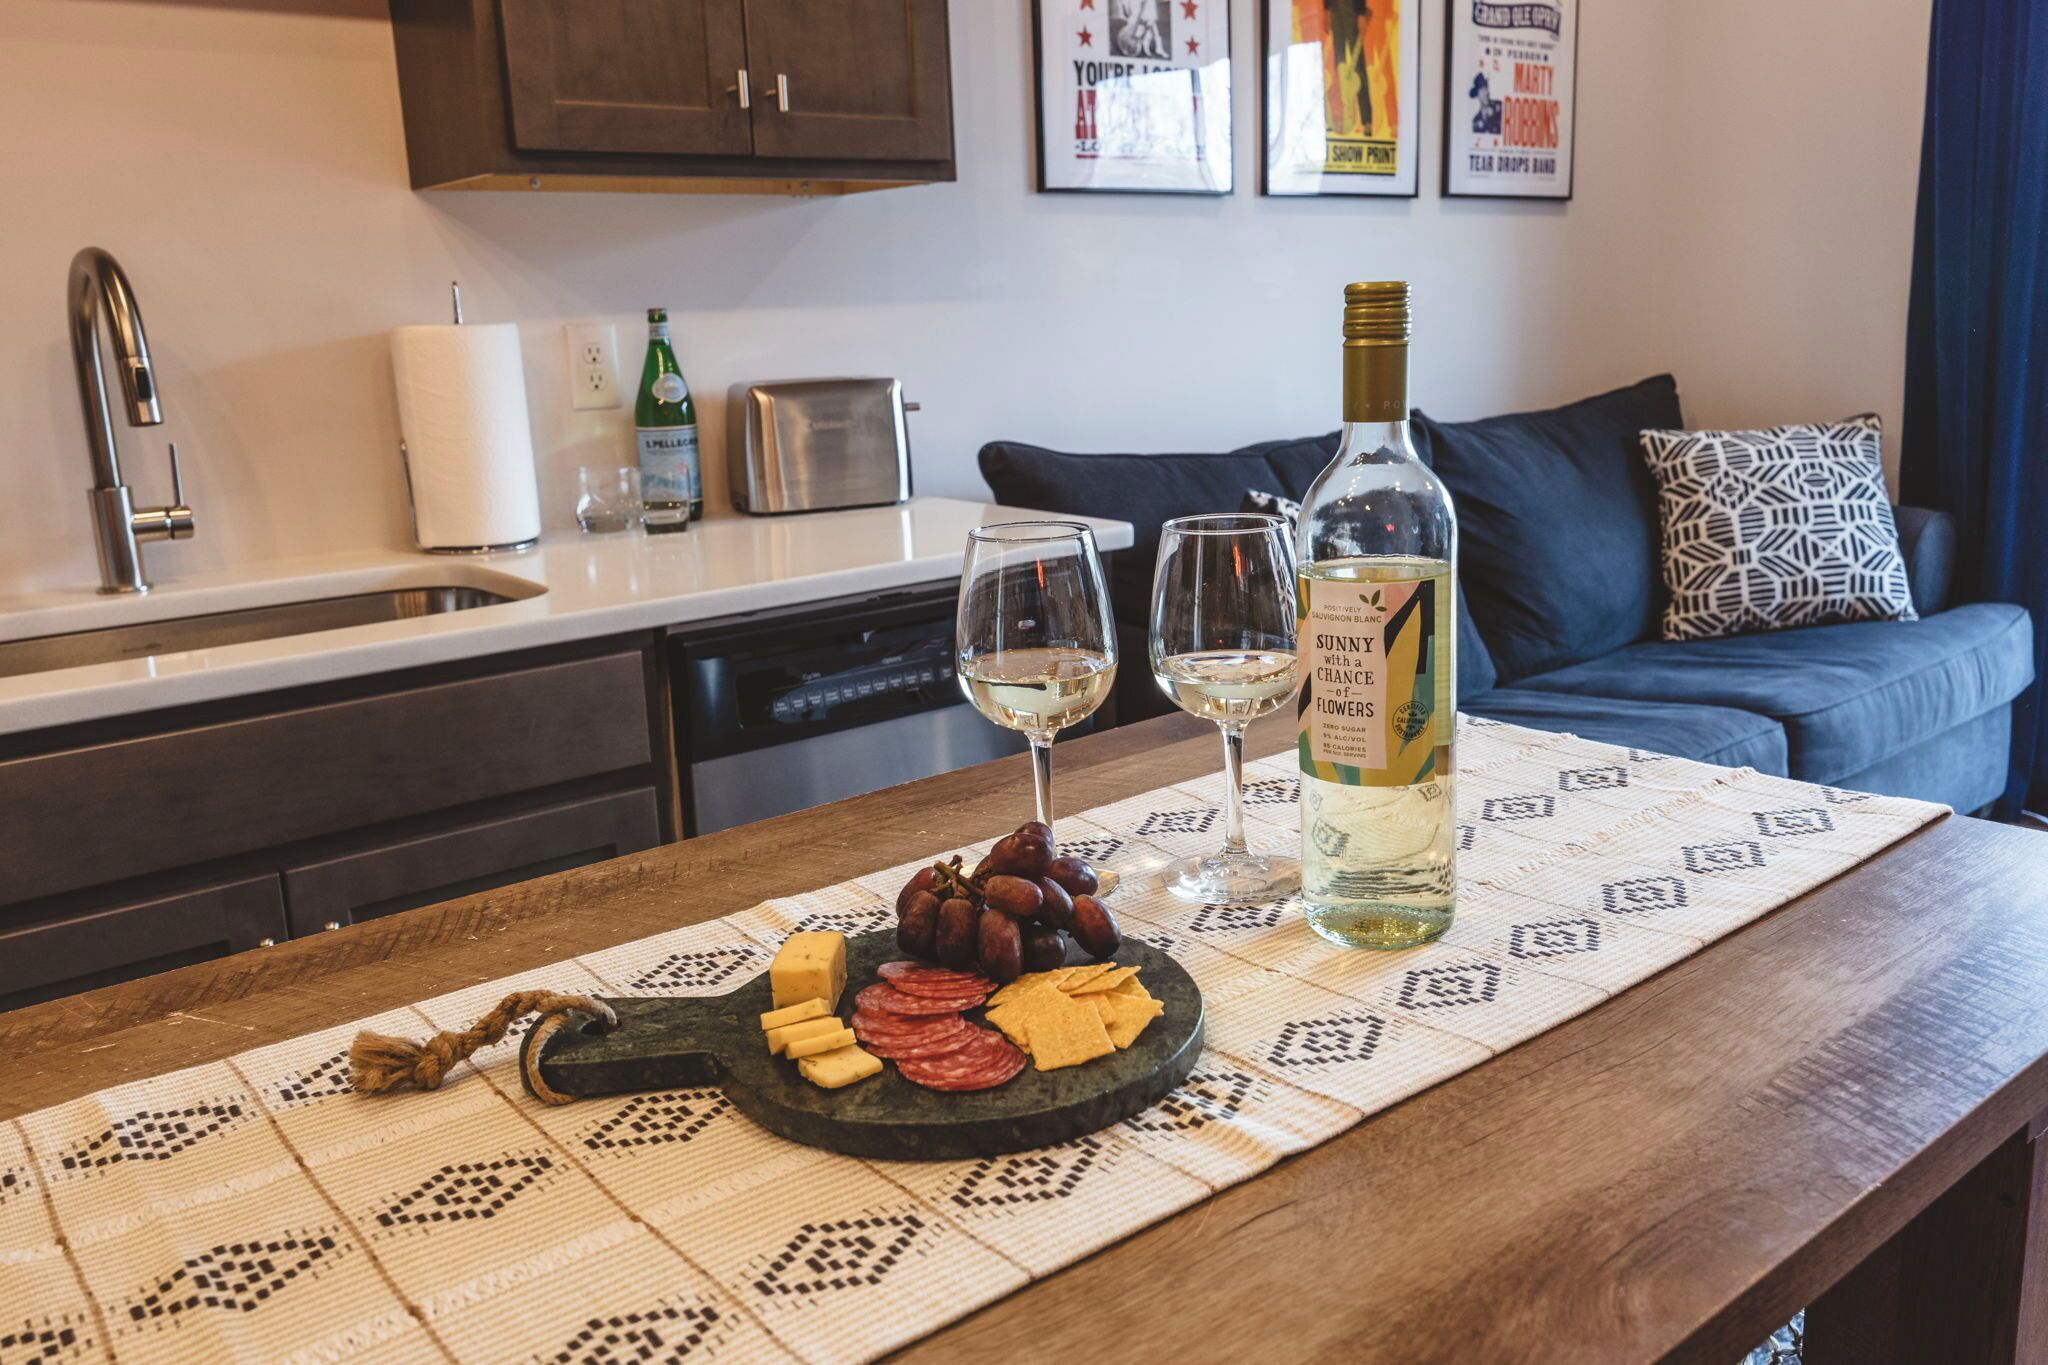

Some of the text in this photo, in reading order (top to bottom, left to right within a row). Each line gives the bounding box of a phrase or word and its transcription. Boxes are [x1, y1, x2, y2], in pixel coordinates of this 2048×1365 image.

[1514, 62, 1553, 96] MARTY
[1503, 96, 1558, 149] ROBBINS
[1332, 145, 1362, 162] SHOW
[1366, 146, 1396, 164] PRINT
[1469, 155, 1555, 174] TEAR DROPS BAND
[1311, 611, 1382, 623] SAUVIGNON BLANC
[1323, 604, 1361, 613] POSITIVELY
[1316, 634, 1375, 653] SUNNY
[1324, 654, 1362, 668] with a
[1317, 666, 1375, 686] CHANCE
[1317, 697, 1374, 718] FLOWERS
[1322, 722, 1366, 733] ZERO SUGAR
[1334, 734, 1366, 743] ALC/VOL
[1332, 744, 1366, 753] CALORIES
